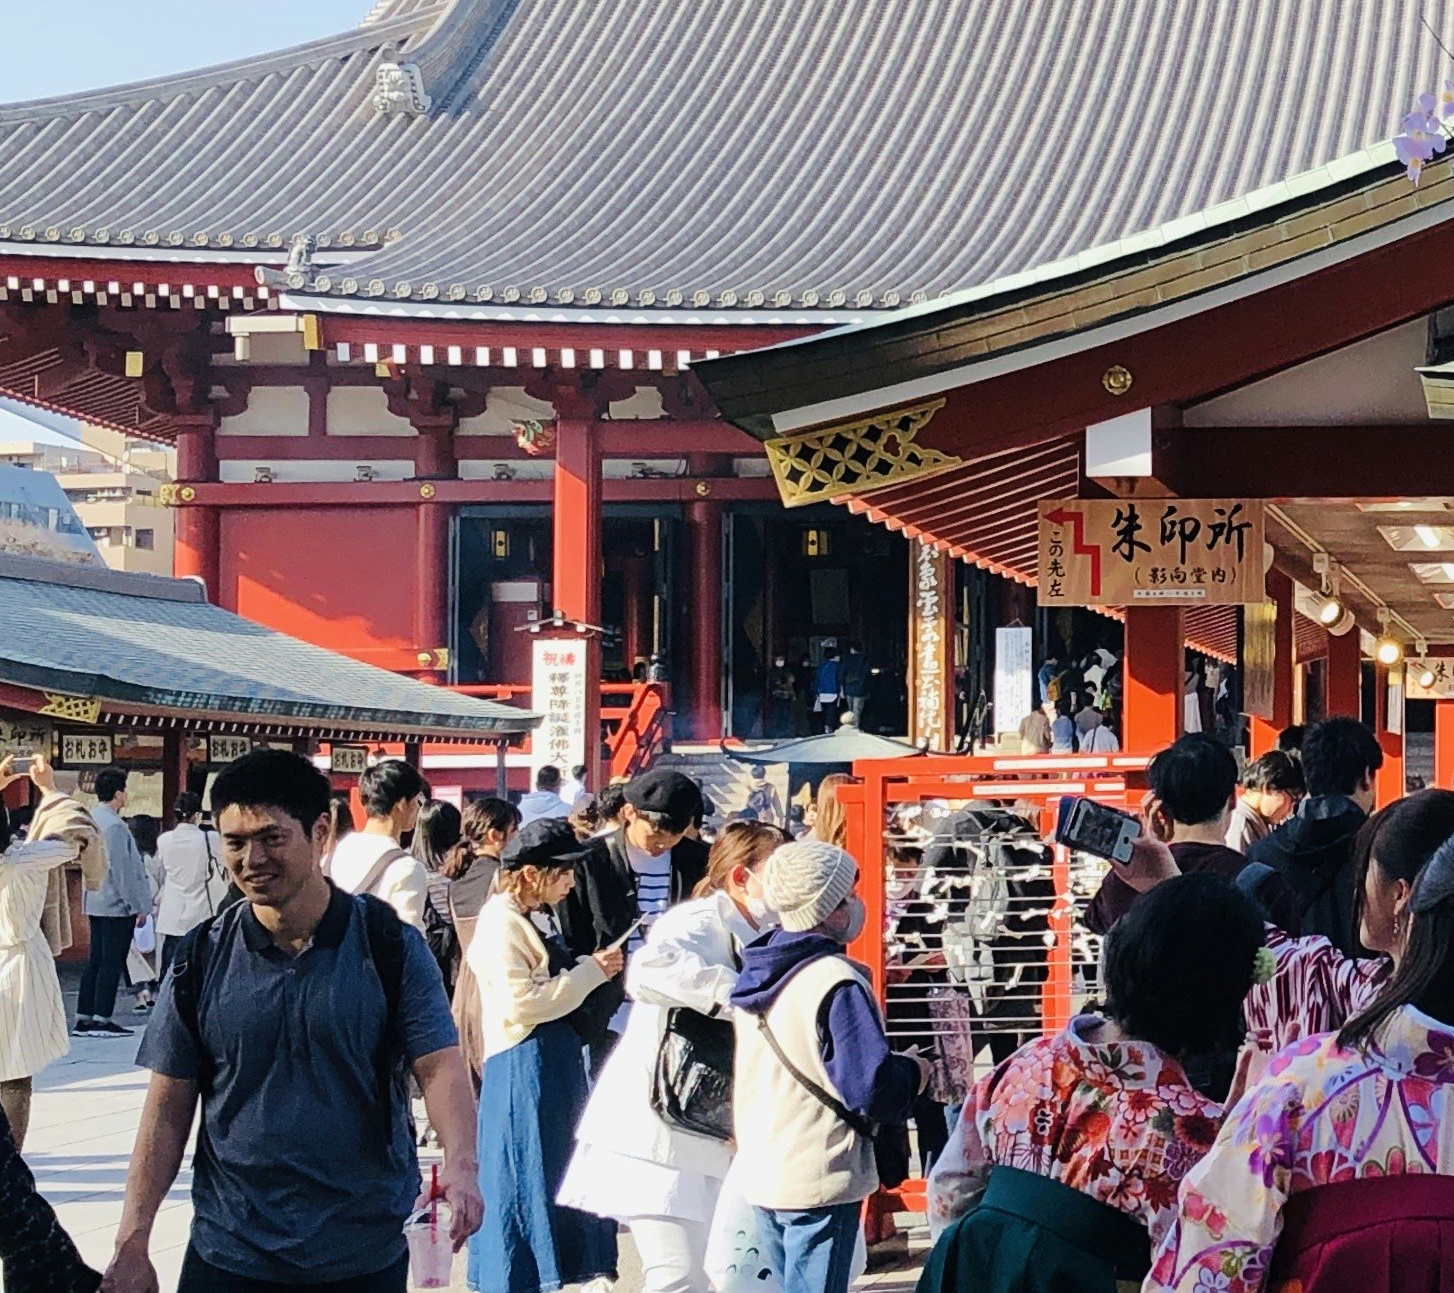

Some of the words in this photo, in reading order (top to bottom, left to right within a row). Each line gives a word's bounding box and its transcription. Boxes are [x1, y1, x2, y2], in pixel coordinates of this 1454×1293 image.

[1047, 531, 1065, 597] この先左
[1110, 503, 1253, 565] 朱印所
